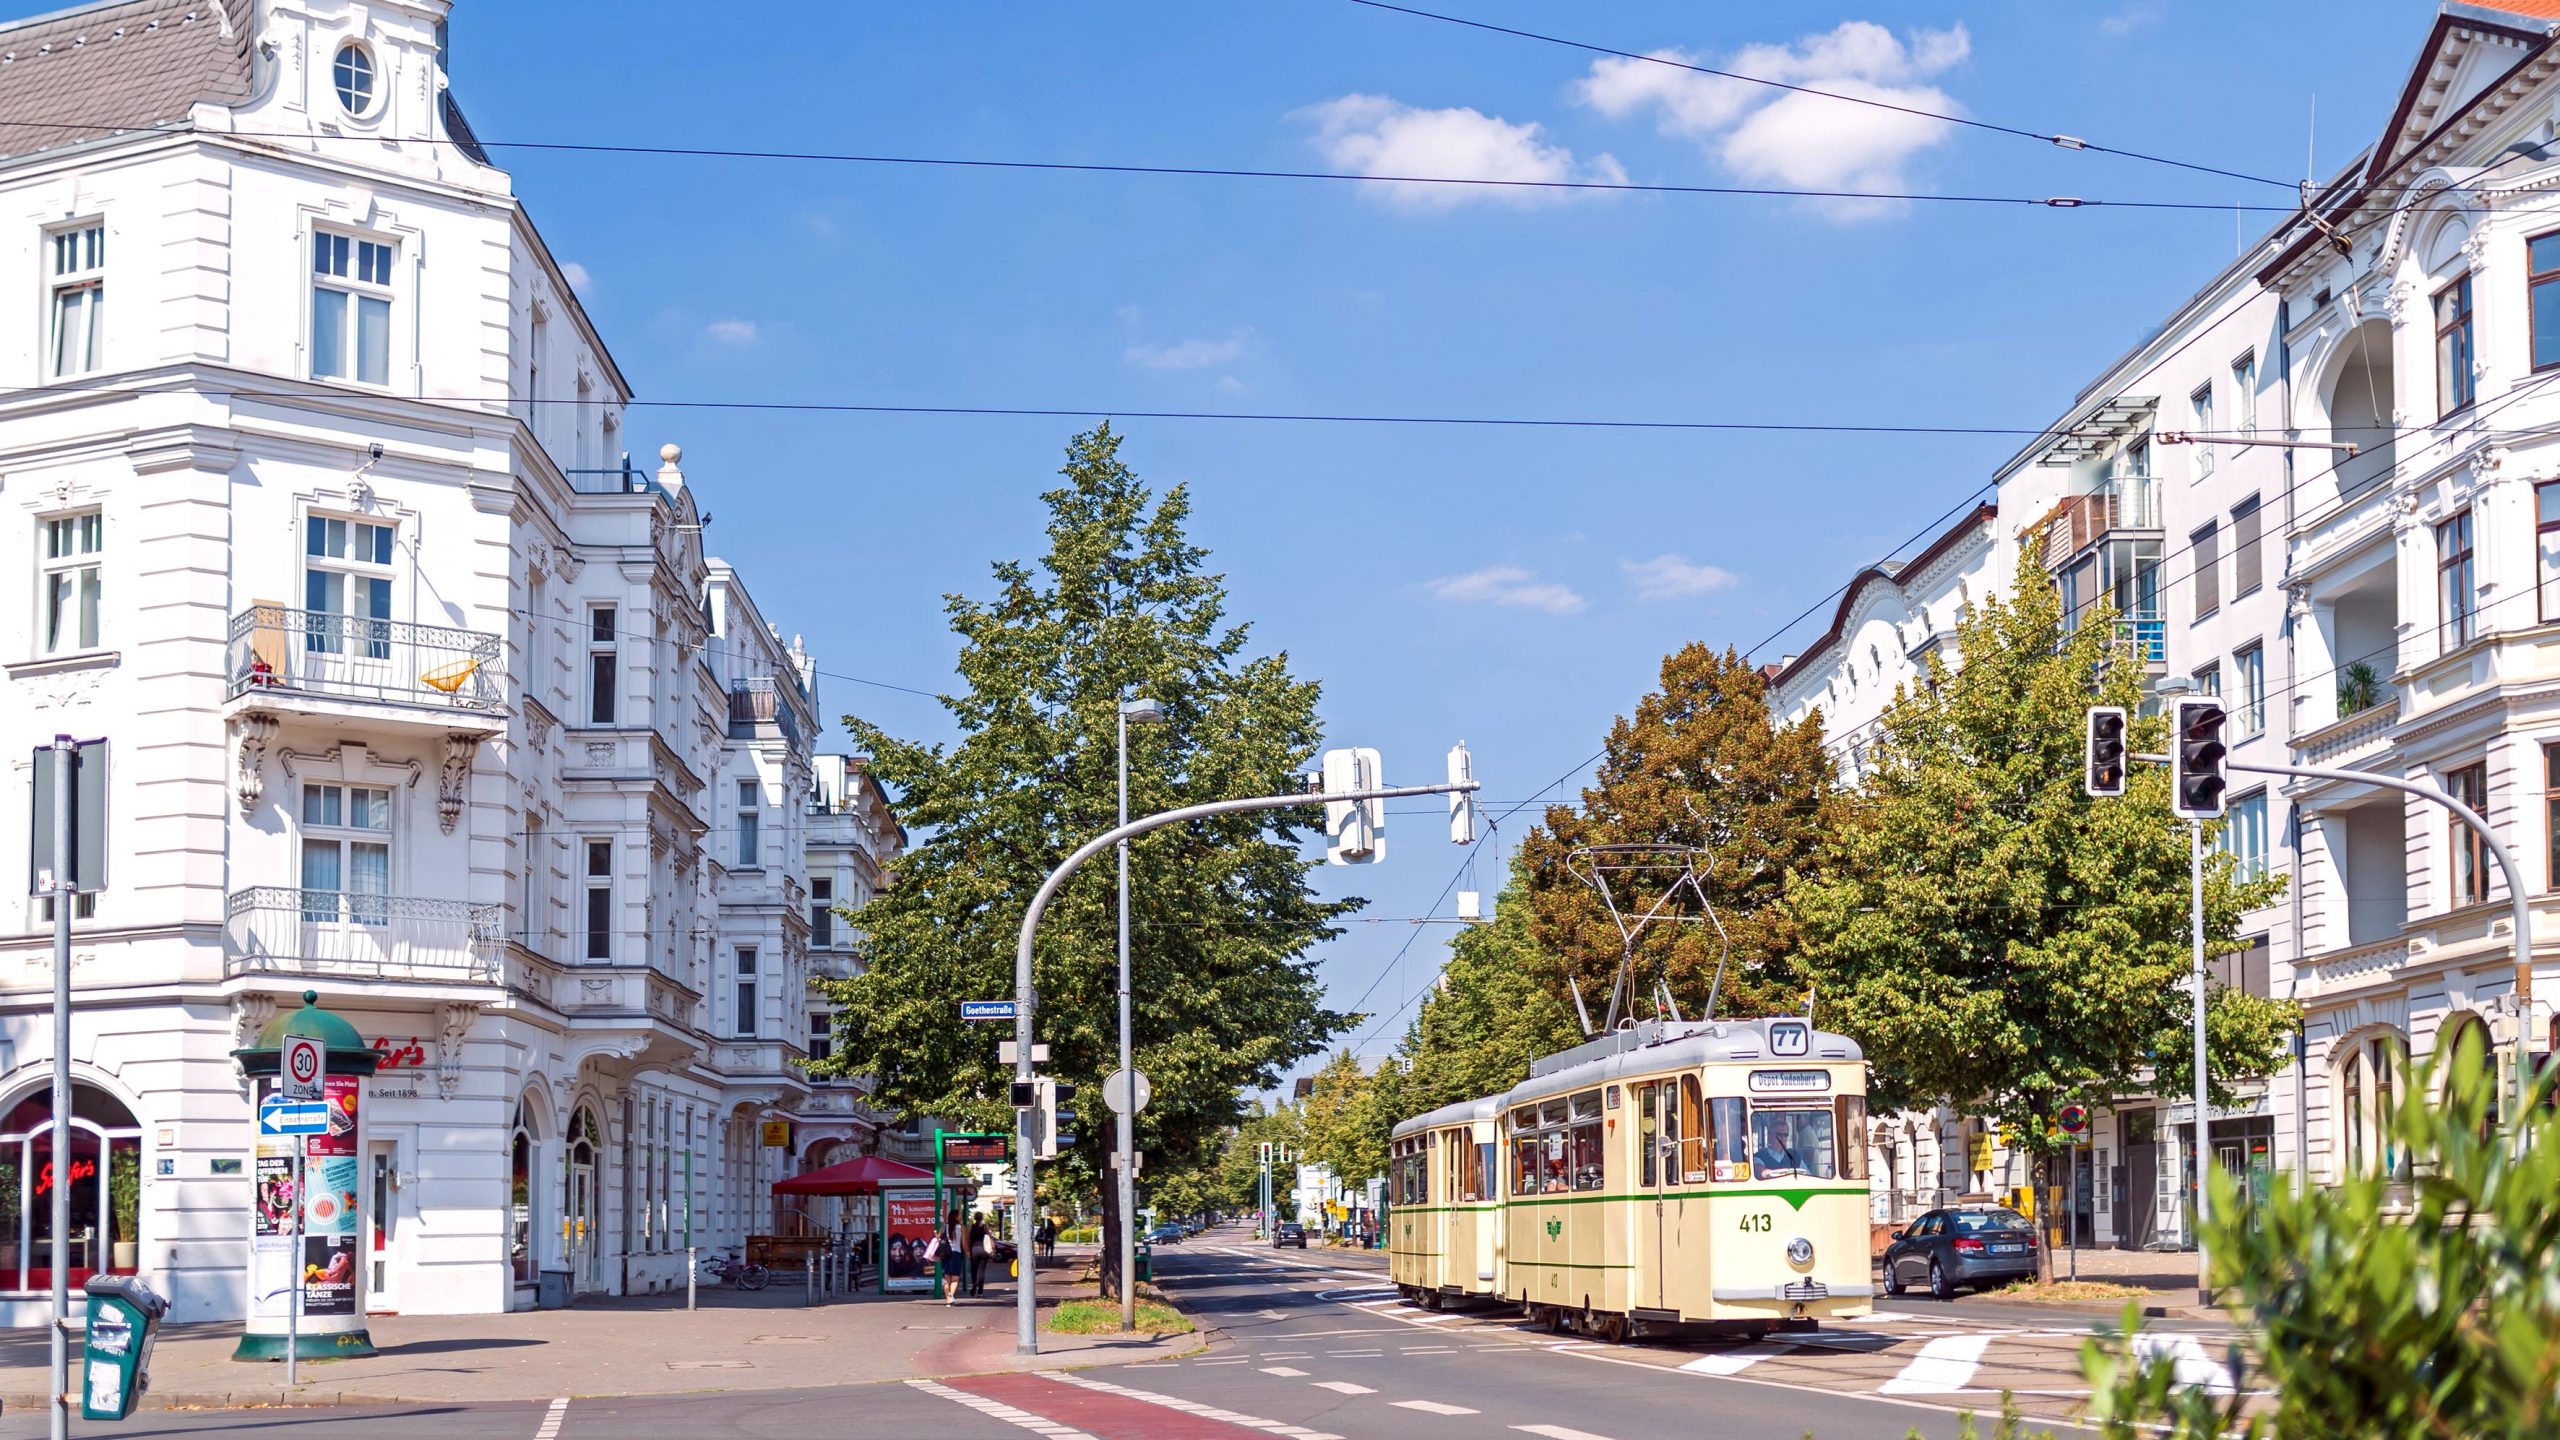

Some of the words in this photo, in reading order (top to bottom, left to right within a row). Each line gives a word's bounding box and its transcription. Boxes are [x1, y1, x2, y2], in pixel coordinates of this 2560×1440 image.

[965, 1004, 1013, 1015] Goethestraße
[1773, 1029, 1802, 1047] 77
[296, 1053, 312, 1072] 30
[1404, 1059, 1411, 1070] E
[1758, 1073, 1779, 1087] Depot
[293, 1084, 314, 1097] ZONE
[379, 1088, 397, 1097] Seit
[269, 1159, 285, 1167] DER
[257, 1167, 288, 1175] OFFENEN
[1739, 1213, 1772, 1232] 413
[305, 1282, 352, 1291] KLASSISCHE
[305, 1290, 333, 1299] TÄNZE
